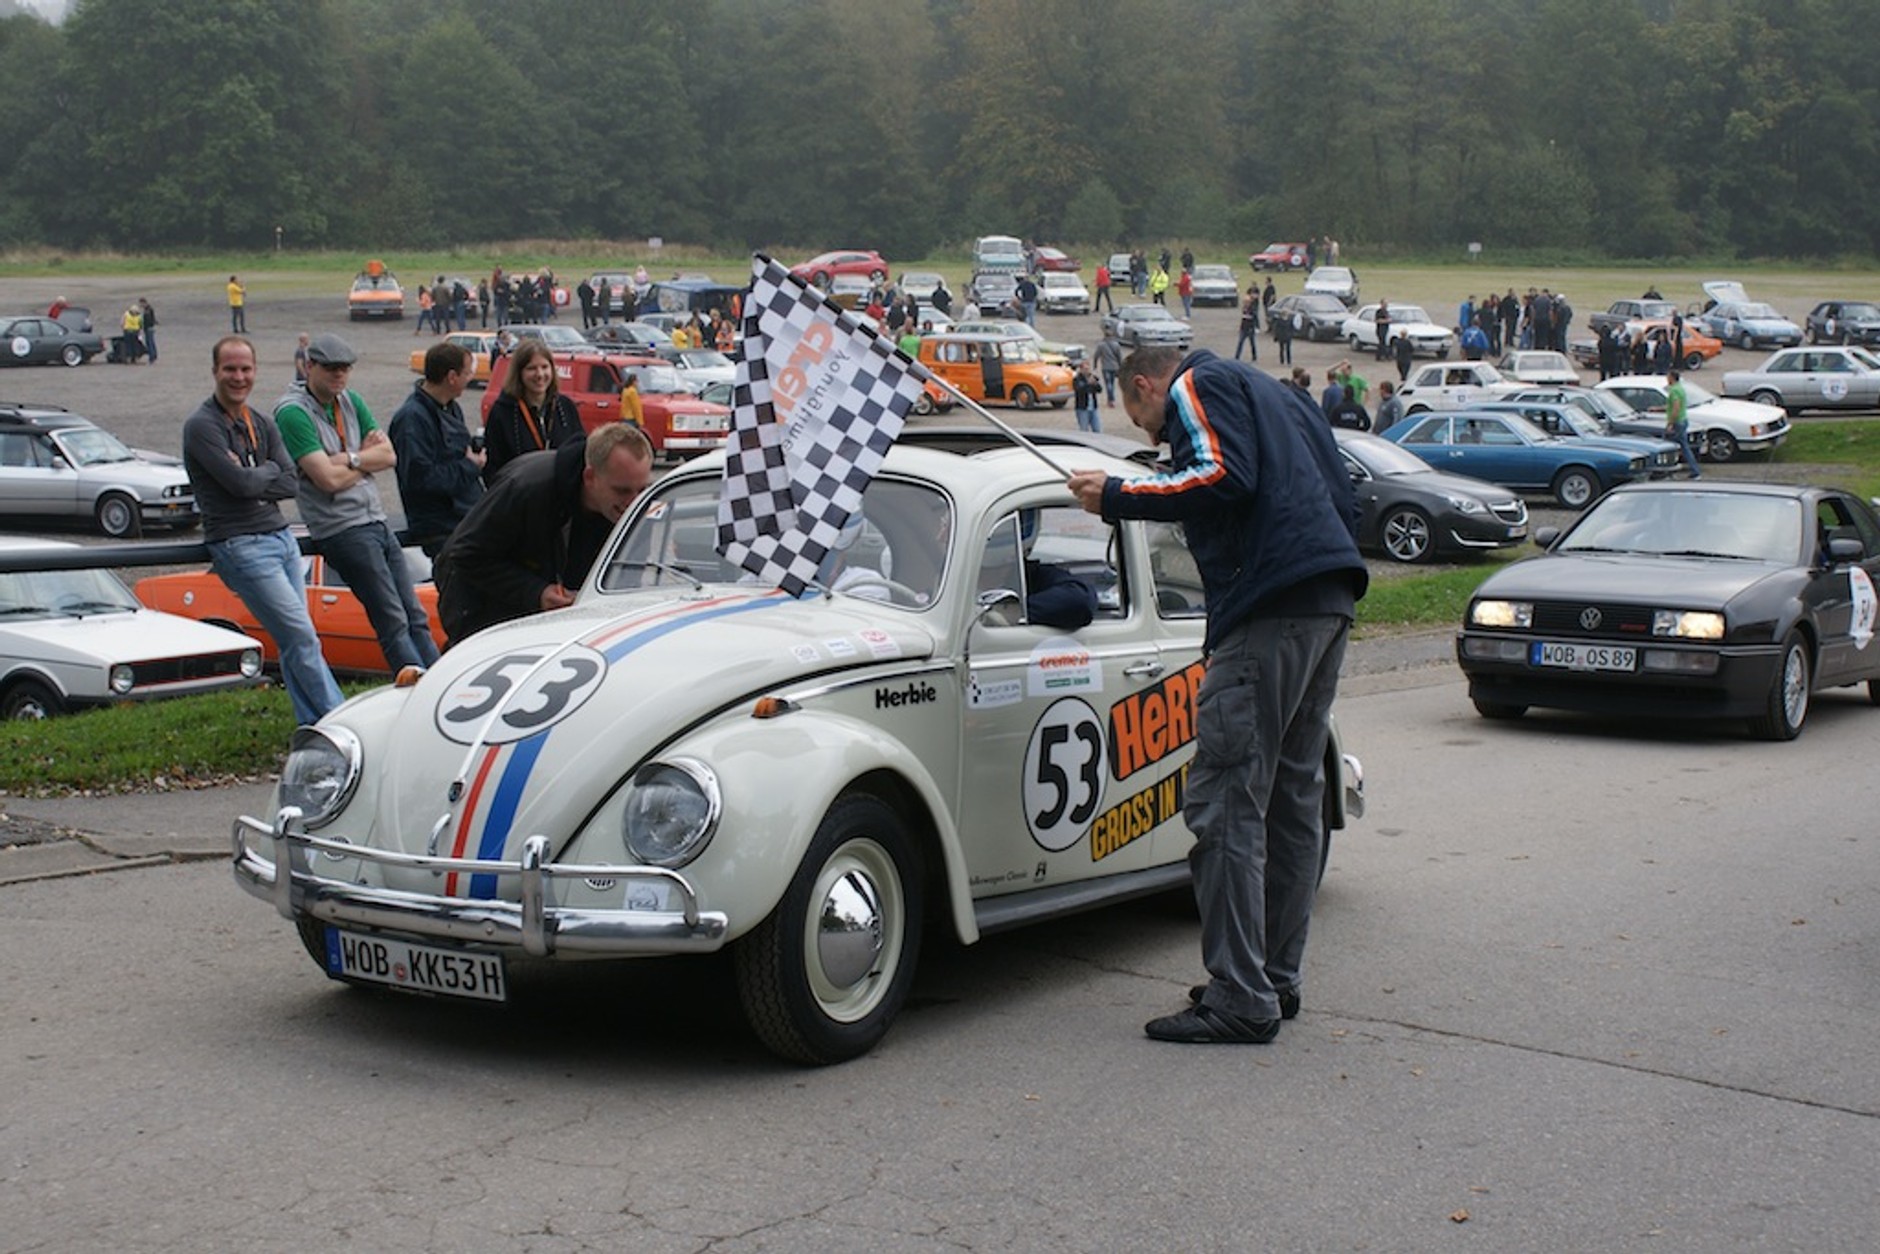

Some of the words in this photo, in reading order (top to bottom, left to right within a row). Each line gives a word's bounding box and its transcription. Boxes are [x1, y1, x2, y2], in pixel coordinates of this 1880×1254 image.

[1543, 646, 1575, 664] WOB
[1587, 649, 1608, 666] OS
[1612, 650, 1633, 668] 89
[445, 655, 599, 728] 53
[875, 681, 936, 709] Herbie
[1035, 720, 1099, 829] 53
[1092, 788, 1155, 862] GROSS
[1158, 776, 1177, 824] IN
[342, 937, 389, 976] WOB
[409, 949, 500, 995] KK53H
